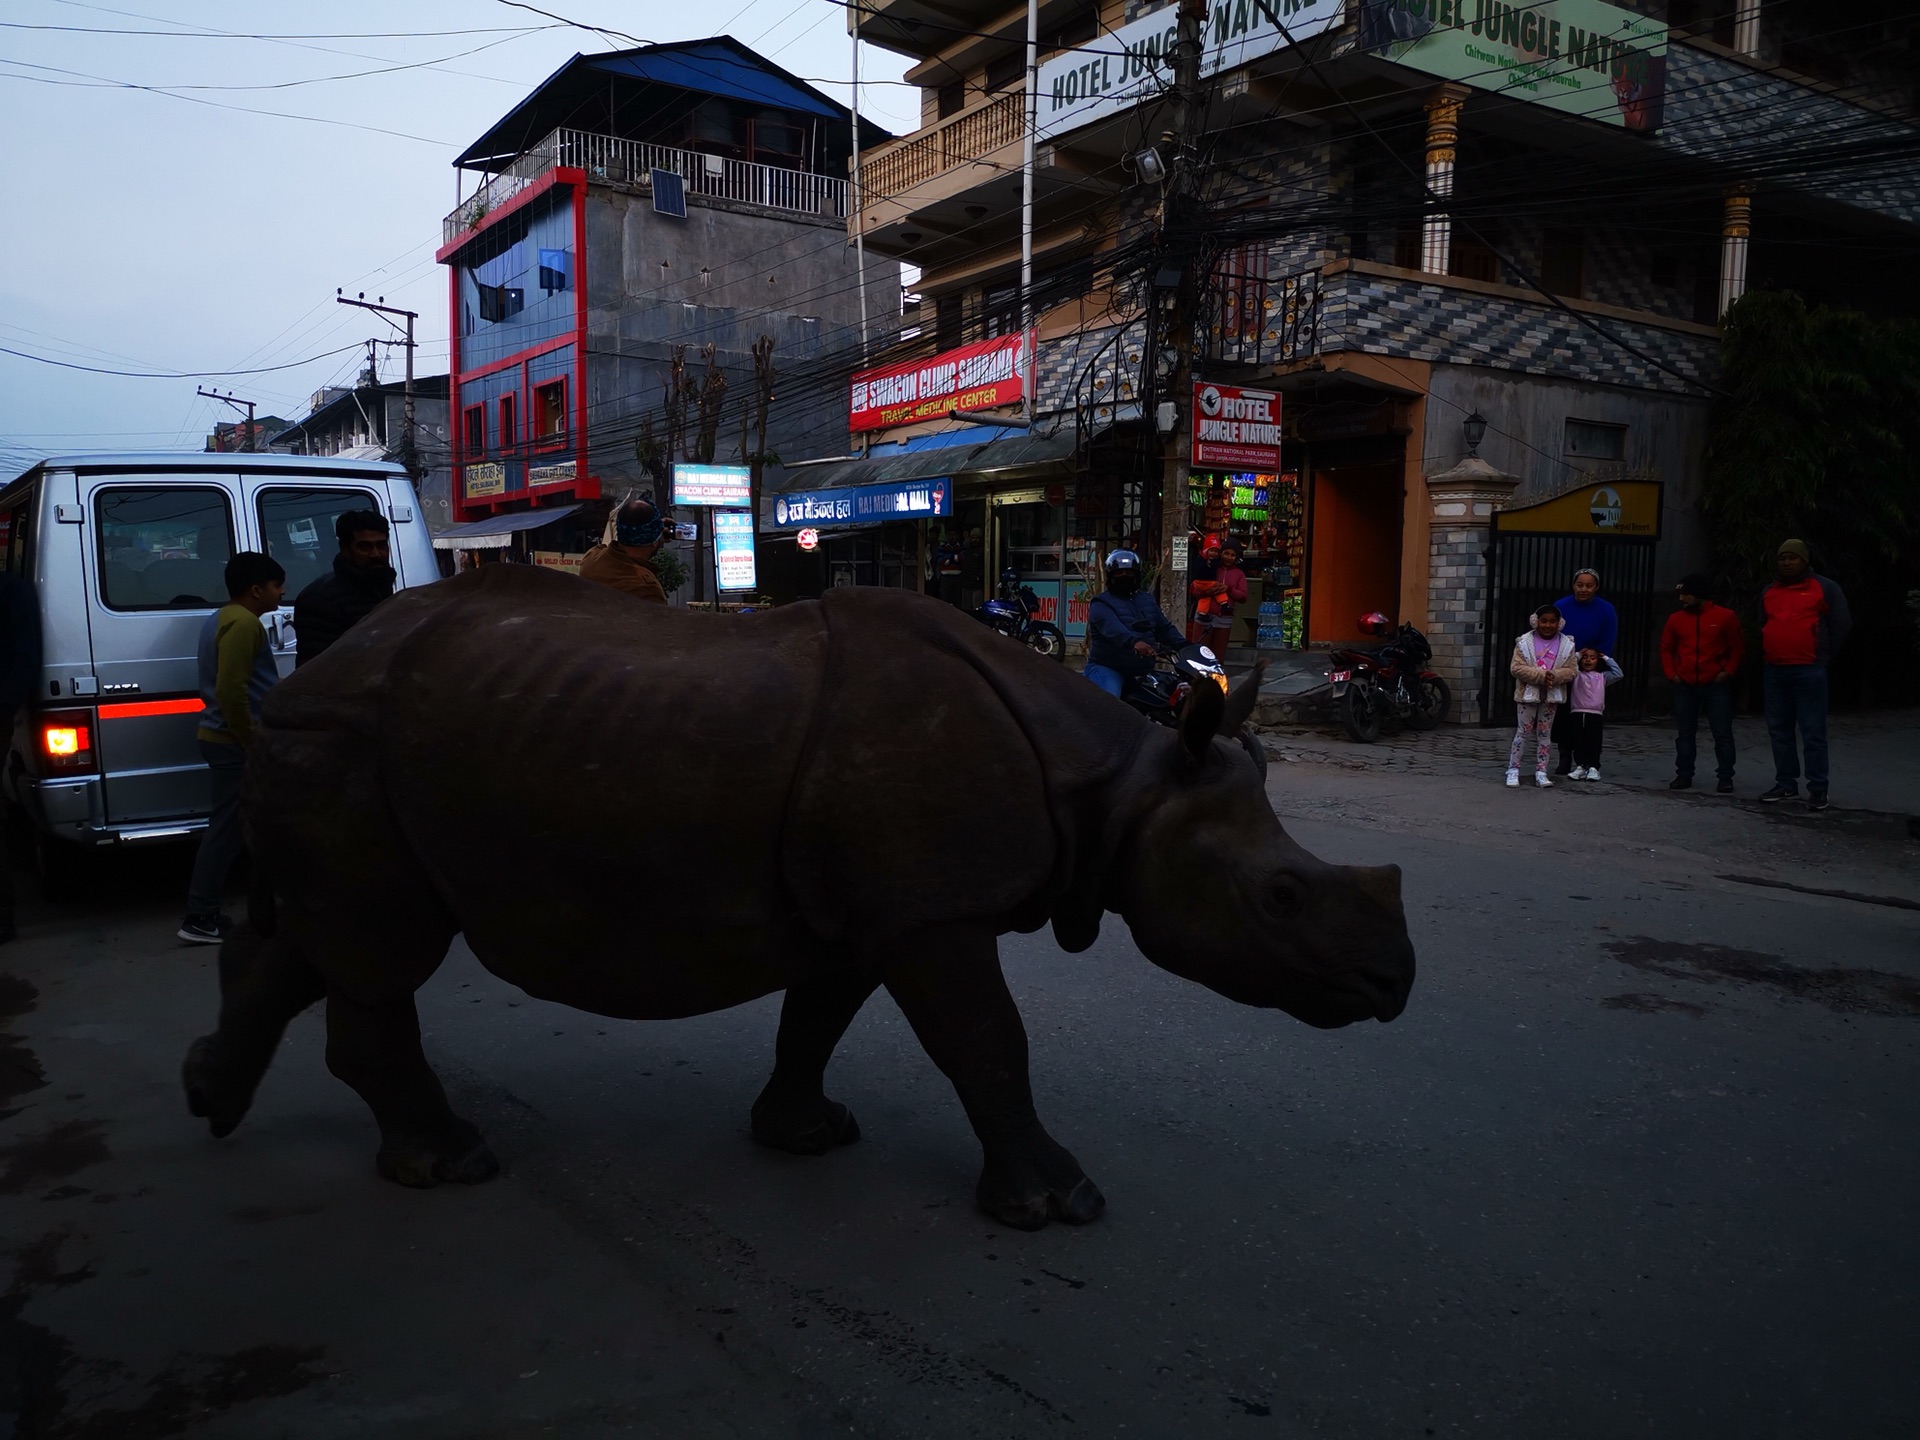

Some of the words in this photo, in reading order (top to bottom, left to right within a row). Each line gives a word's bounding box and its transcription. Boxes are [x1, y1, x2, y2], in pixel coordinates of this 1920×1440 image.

[1472, 0, 1560, 58] JUNGLE
[1465, 43, 1496, 64] Chitwan
[1051, 56, 1112, 112] HOTEL
[919, 361, 957, 400] CLINIC
[958, 347, 1013, 390] SAURAHA
[880, 407, 913, 424] TRAVEL
[960, 388, 997, 409] CENTER
[1222, 398, 1273, 421] HOTEL
[1197, 420, 1239, 443] JUNGLE
[1240, 422, 1281, 446] NATURE
[858, 496, 873, 515] RAJ
[873, 491, 910, 514] MEDICAL
[103, 682, 142, 695] TATA
